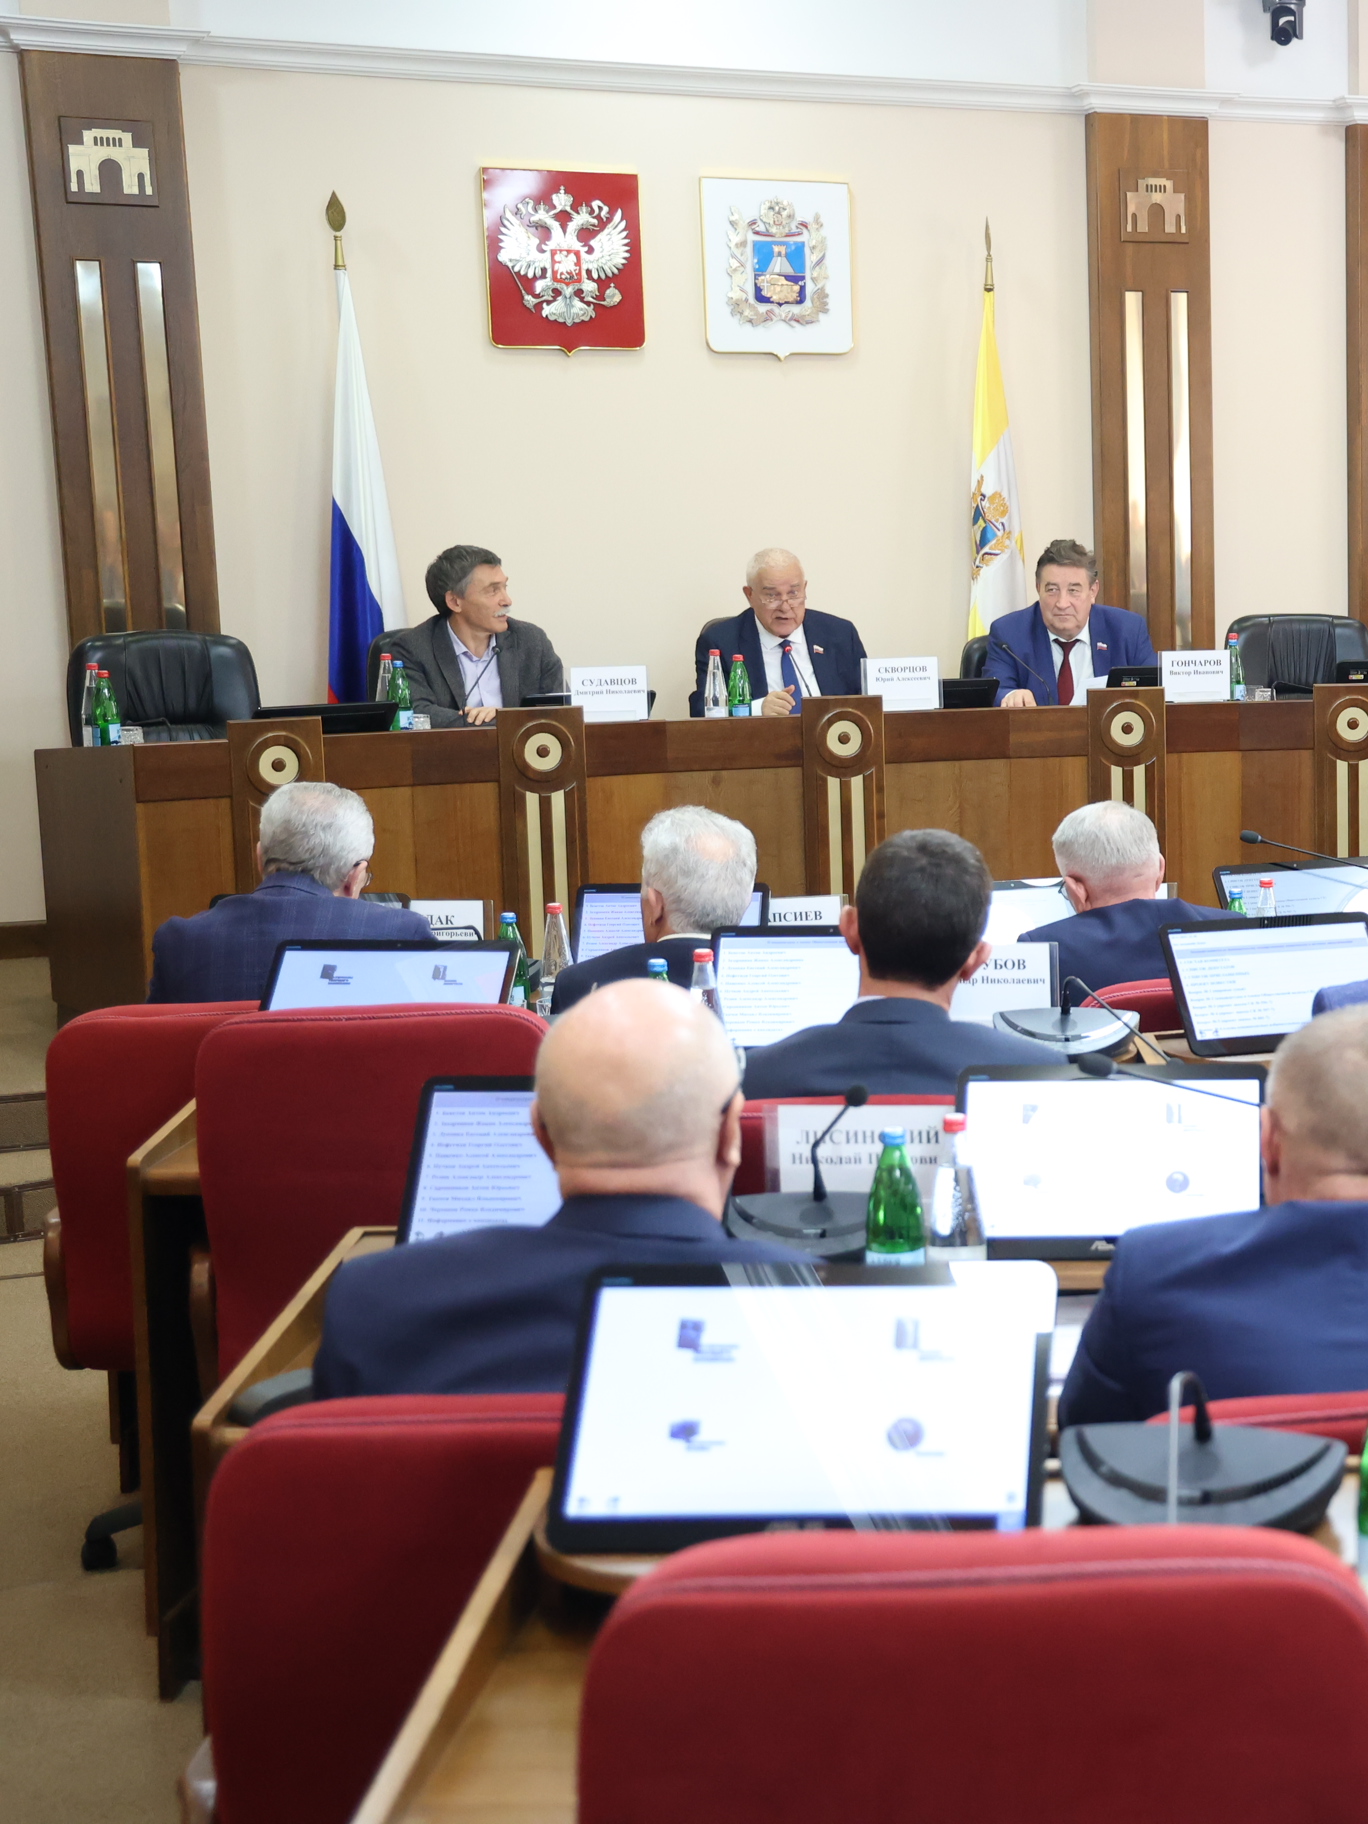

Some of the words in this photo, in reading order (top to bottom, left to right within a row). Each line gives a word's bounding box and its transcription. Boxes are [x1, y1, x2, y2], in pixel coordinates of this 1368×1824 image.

[1171, 659, 1222, 667] ГОНЧАРОВ
[878, 665, 928, 675] СКВОРЦОВ
[581, 678, 637, 687] СУДАВЦОВ
[574, 689, 604, 697] Дмитрий
[605, 688, 645, 696] Николаевич
[981, 975, 1046, 985] Николаевич
[796, 1126, 940, 1145] ЛИСИНИЙ
